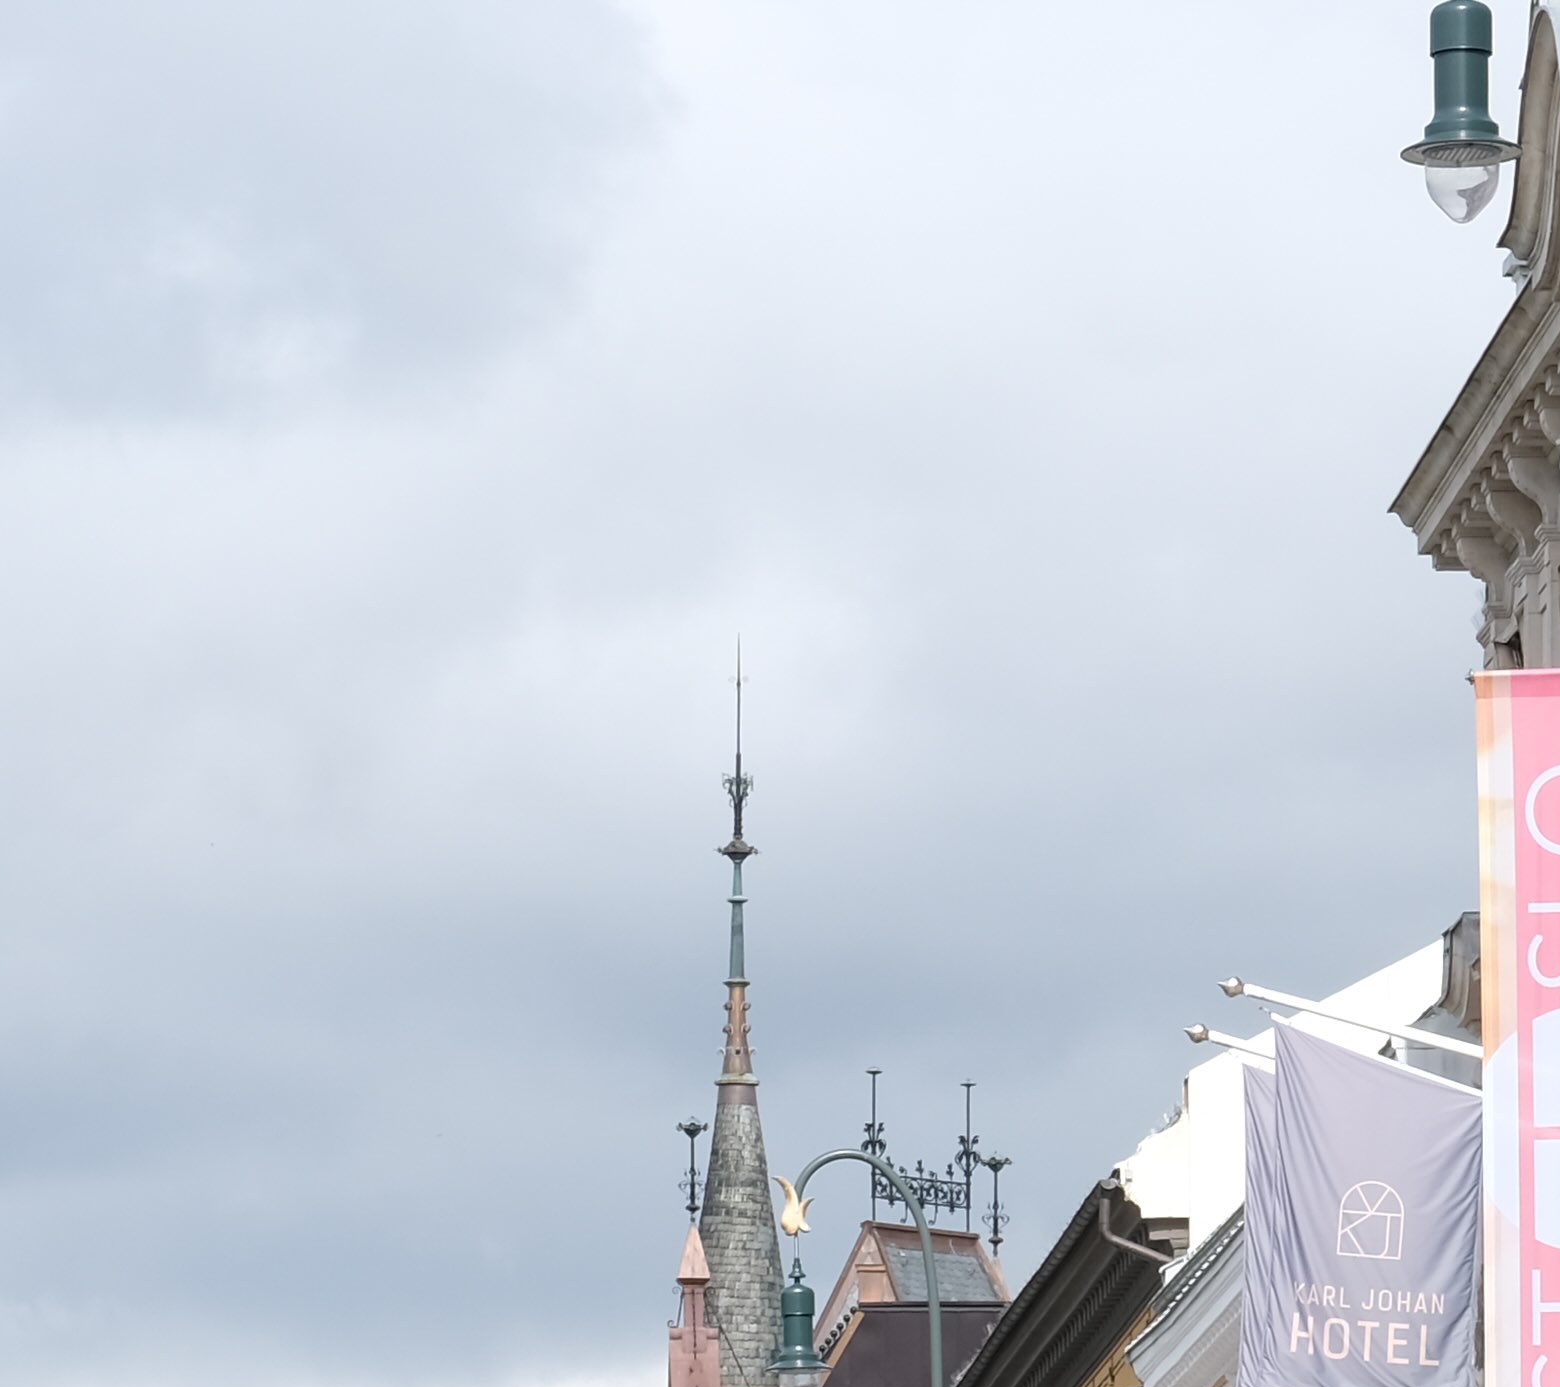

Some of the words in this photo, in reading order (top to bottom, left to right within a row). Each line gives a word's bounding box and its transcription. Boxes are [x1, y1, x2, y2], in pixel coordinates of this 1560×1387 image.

[1293, 1281, 1352, 1310] KARL
[1361, 1289, 1445, 1315] JOHAN
[1289, 1312, 1441, 1367] HOTEL
